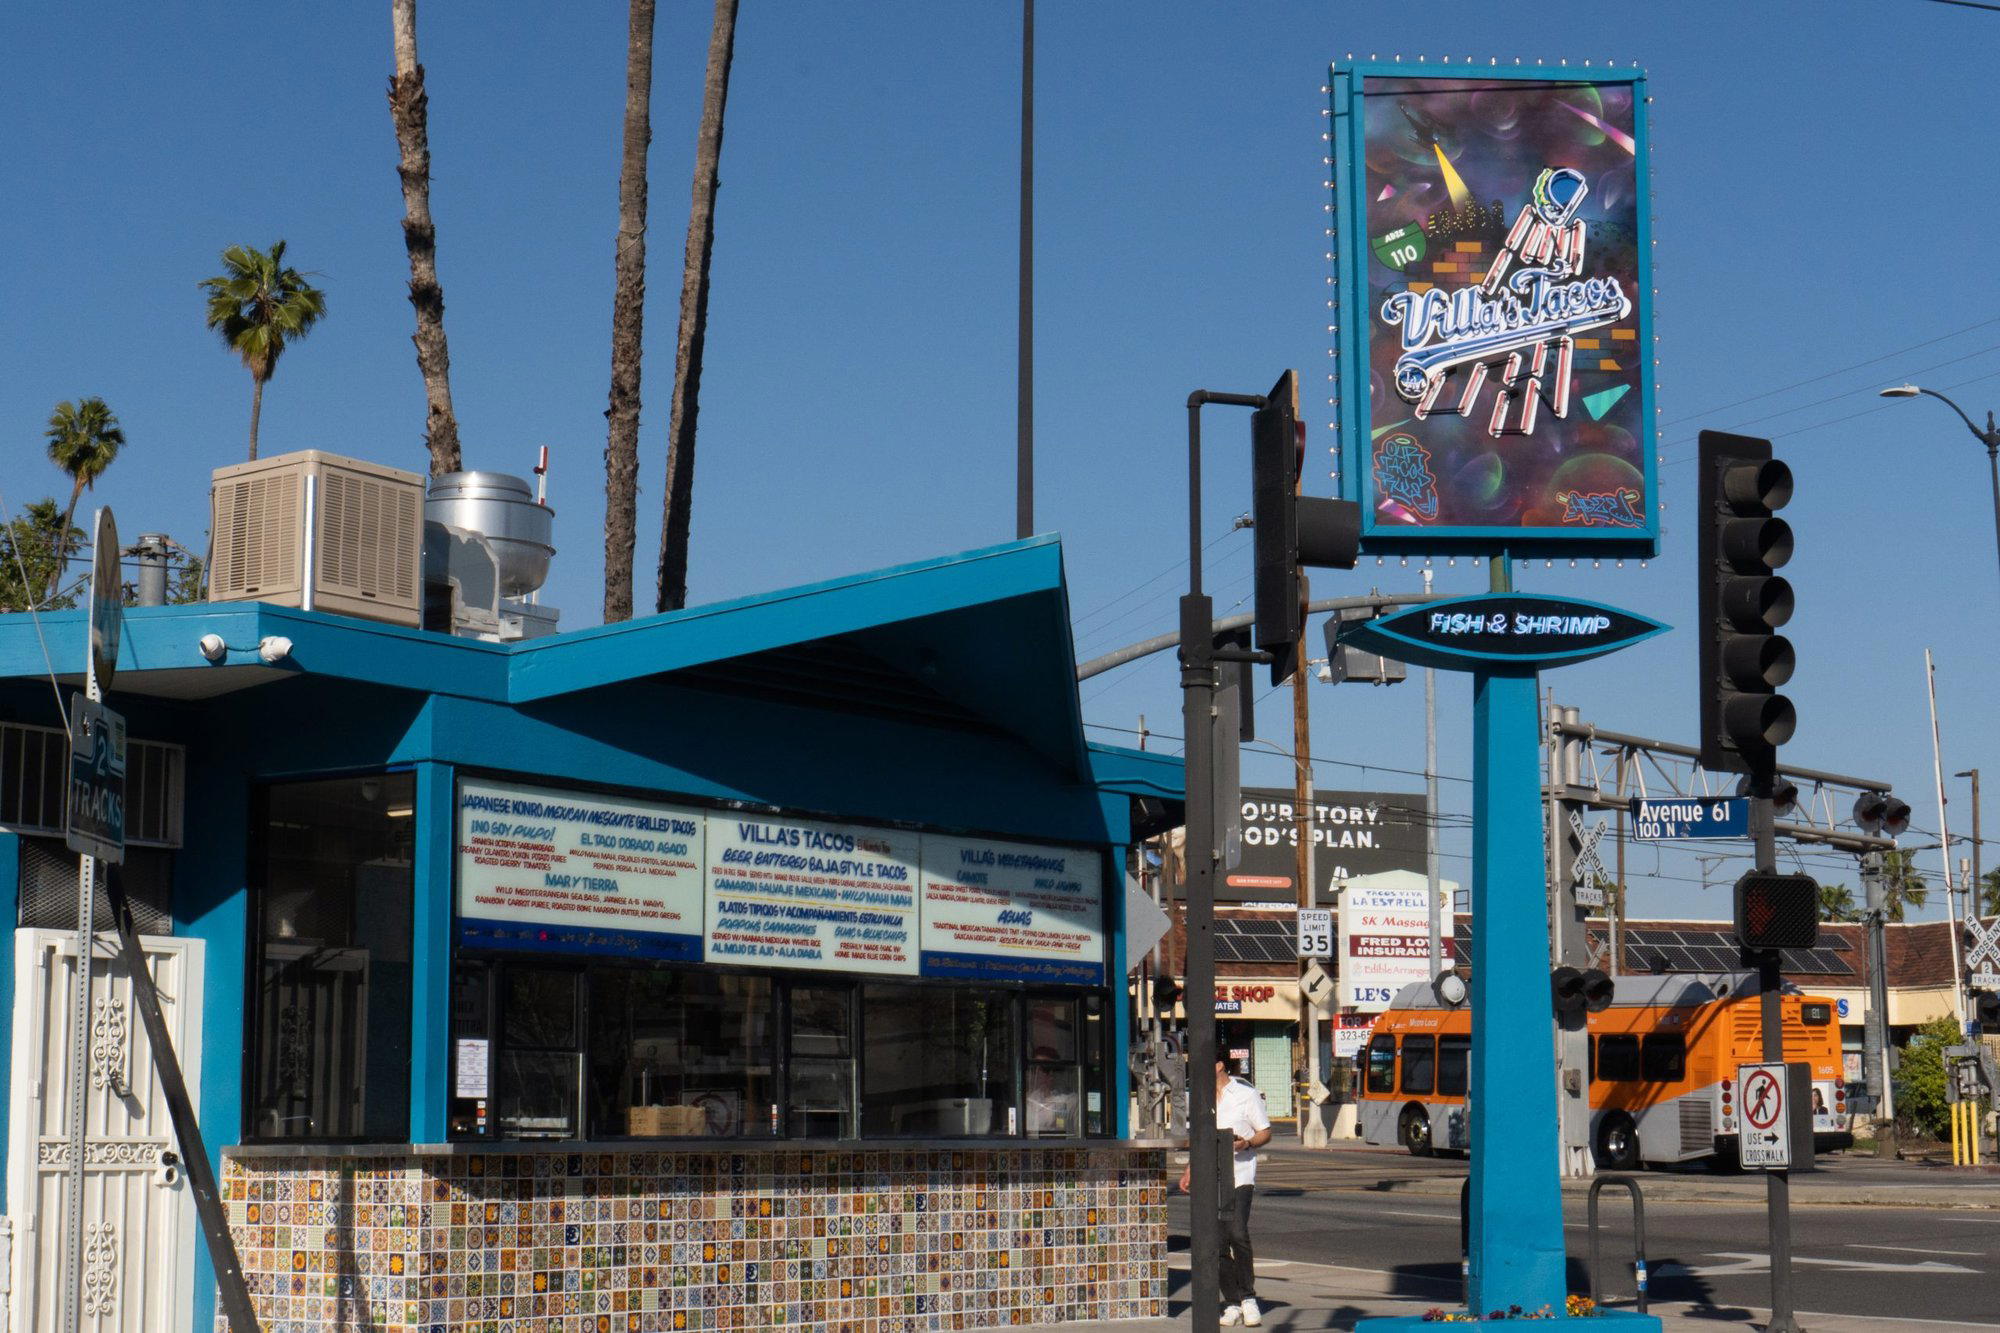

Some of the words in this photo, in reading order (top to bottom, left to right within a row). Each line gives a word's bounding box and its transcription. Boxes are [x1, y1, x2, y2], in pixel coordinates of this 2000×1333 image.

[1391, 245, 1417, 267] 110
[1381, 284, 1519, 350] Villa's
[1510, 268, 1630, 324] Tacos
[1430, 612, 1483, 634] FISH
[1487, 613, 1506, 634] &
[1513, 612, 1610, 635] SHRIMP
[97, 736, 109, 776] 2
[72, 779, 122, 828] TRACKS
[1638, 801, 1703, 822] Avenue
[1712, 801, 1730, 822] 61
[462, 794, 511, 814] JAPANESE
[543, 805, 588, 824] MEXICAN
[588, 809, 634, 829] MESQUITE
[635, 815, 670, 833] GRILLED
[670, 819, 697, 837] TACOS
[1241, 802, 1293, 822] OUR
[1316, 805, 1384, 826] TORY.
[738, 822, 800, 847] VILLA'S
[803, 830, 855, 852] TACOS
[1240, 826, 1298, 846] OD'S
[1314, 829, 1380, 849] PLAN.
[1639, 823, 1660, 838] 100
[1666, 822, 1675, 837] N
[581, 832, 593, 845] EL
[594, 834, 616, 849] TACO
[619, 836, 655, 852] DORADO
[657, 841, 688, 856] ASADO
[1571, 813, 1586, 843] RAIL
[1590, 851, 1608, 884] ROAD
[1575, 821, 1606, 876] CROSSING
[722, 847, 753, 865] BEER
[754, 851, 808, 870] BATTERED
[808, 857, 839, 874] BAJA
[840, 860, 874, 877] STYLE
[876, 863, 908, 881] TACOS
[545, 873, 571, 888] MAR
[572, 876, 582, 888] Y
[582, 877, 619, 892] TIERRA
[714, 878, 757, 892] CAMARON
[758, 883, 794, 896] SALVAJE
[1587, 877, 1592, 889] 2
[495, 885, 513, 895] WILD
[515, 887, 570, 900] MEDITERRANEAN
[570, 892, 583, 900] SEA
[1577, 891, 1602, 901] TRACKS
[1352, 897, 1368, 906] LA
[1372, 898, 1427, 907] ESTRELL
[997, 909, 1032, 925] AGUAS
[1301, 913, 1329, 922] SPEED
[1361, 916, 1378, 926] SK
[1381, 916, 1430, 929] Massag
[1303, 923, 1326, 932] LIMIT
[1966, 915, 1982, 940] RAIL
[1303, 934, 1329, 951] 35
[1360, 937, 1401, 947] FRED
[1358, 947, 1448, 957] INSURANE
[1364, 964, 1392, 975] Edible
[1394, 966, 1430, 977] Arrange
[1984, 964, 1990, 974] 2
[1232, 985, 1275, 1003] SHOP
[1354, 988, 1391, 1002] LE'S
[1339, 1016, 1362, 1029] FOR
[1747, 1132, 1762, 1145] USE
[1745, 1149, 1784, 1162] CROSSWALK
